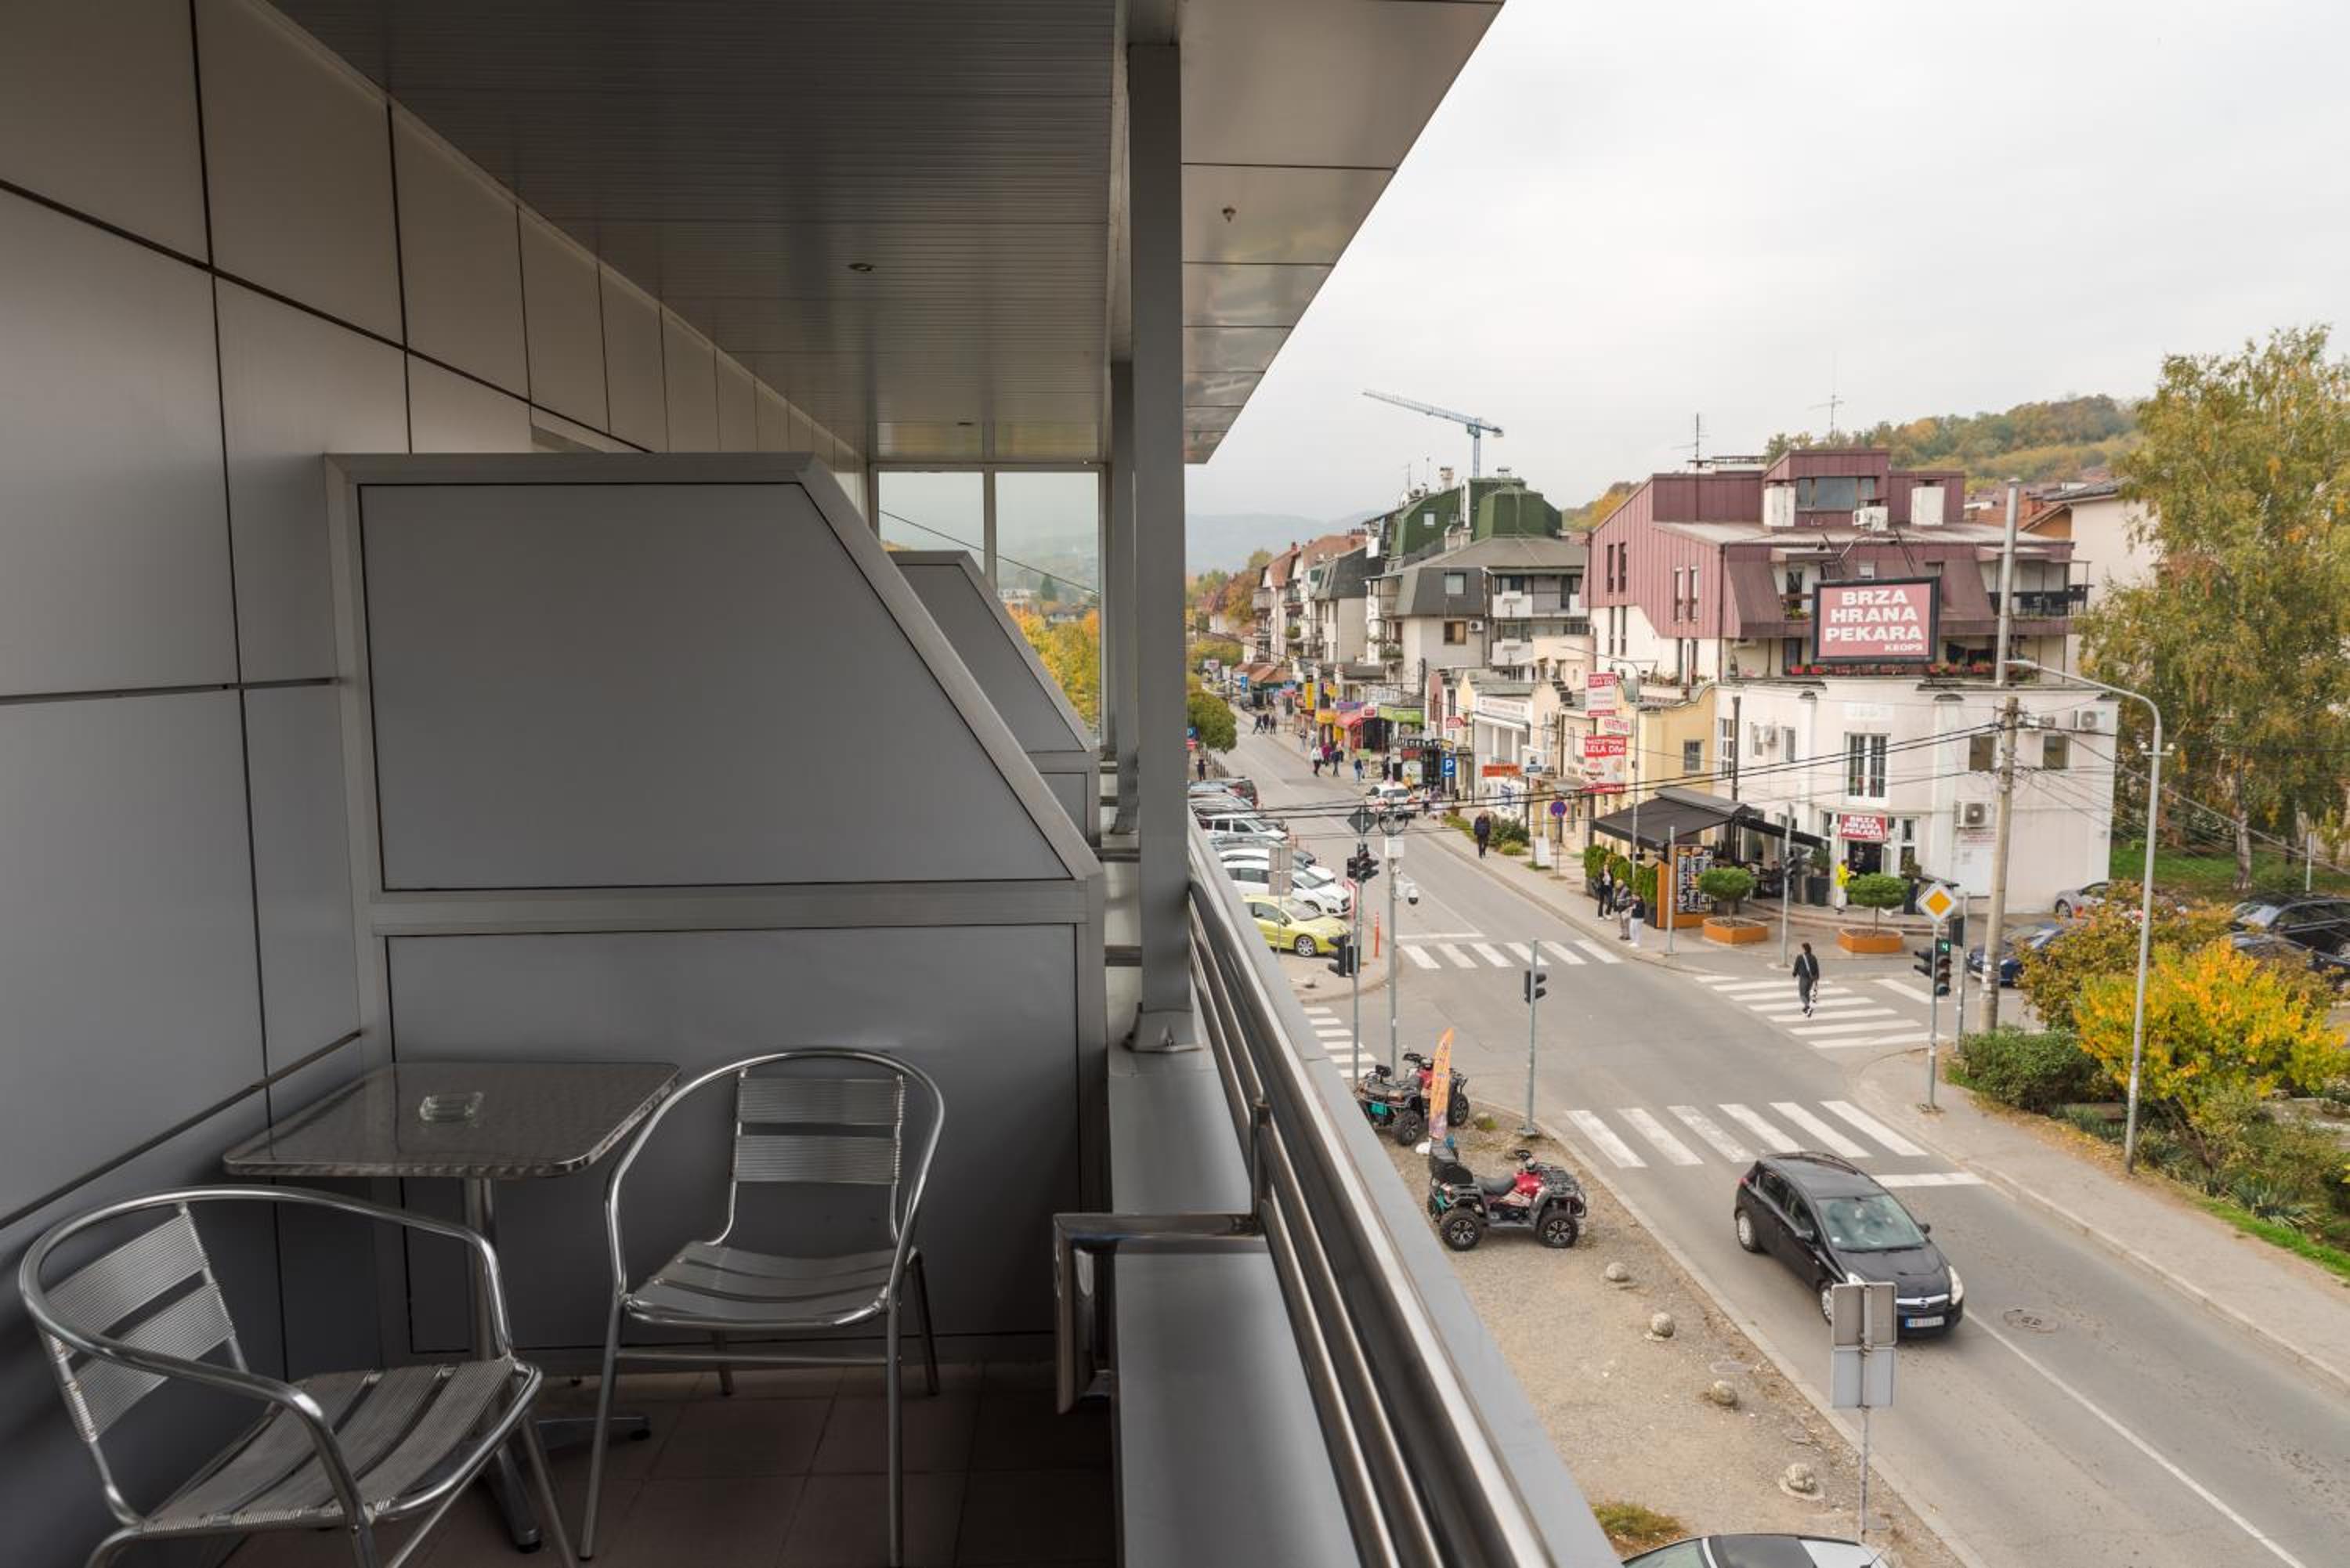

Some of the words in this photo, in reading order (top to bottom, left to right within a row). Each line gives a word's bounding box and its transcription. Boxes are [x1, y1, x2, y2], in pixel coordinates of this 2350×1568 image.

[1842, 589, 1908, 605] BRZA
[1830, 605, 1918, 623] HRANA
[1824, 625, 1923, 642] PEKARA
[1445, 759, 1453, 770] P
